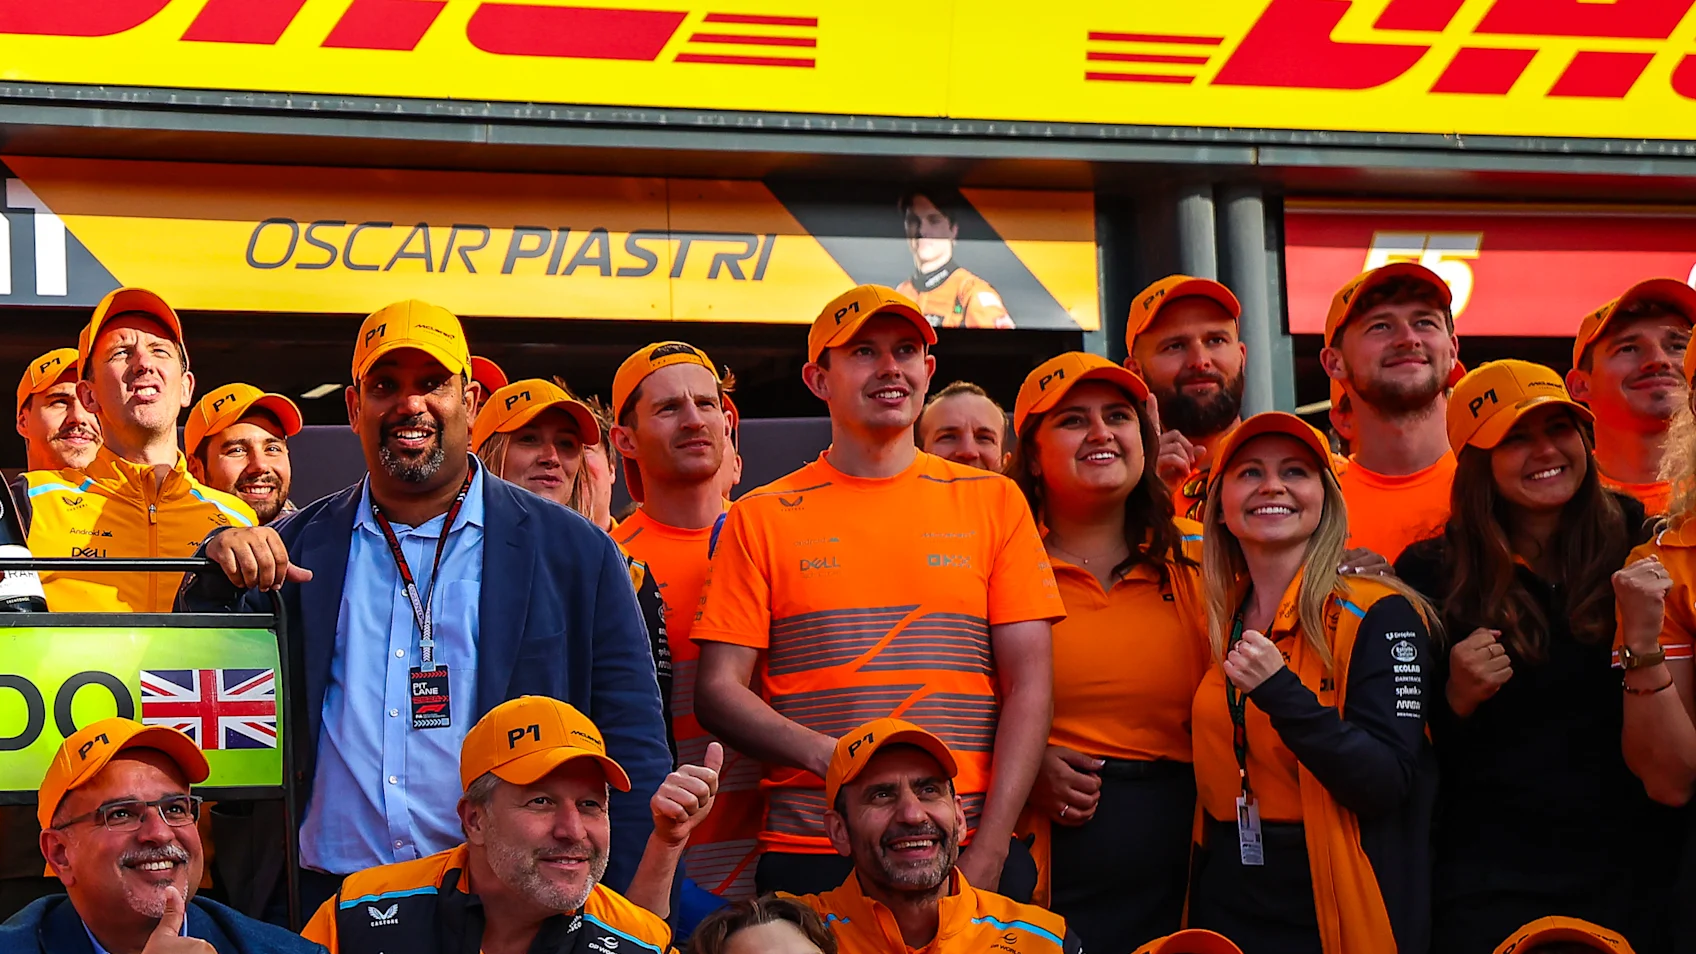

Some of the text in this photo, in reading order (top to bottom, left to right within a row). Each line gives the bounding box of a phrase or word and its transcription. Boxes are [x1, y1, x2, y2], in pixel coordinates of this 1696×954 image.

[246, 217, 777, 283] OSCAR PIASTRI
[1141, 288, 1166, 311] P1
[834, 301, 860, 326] P1
[364, 323, 387, 348] P1
[40, 357, 61, 374] P1
[1038, 367, 1066, 391] P1
[212, 393, 237, 412] P1
[504, 389, 532, 411] P1
[1468, 387, 1499, 418] P1
[70, 526, 100, 537] Android
[800, 556, 841, 571] DELL
[927, 554, 972, 568] OKX
[1393, 665, 1421, 673] ECOLAB
[413, 682, 427, 690] PIT
[413, 688, 439, 696] LANE
[507, 724, 542, 749] P1
[847, 732, 875, 759] P1
[77, 733, 110, 761] P1
[371, 918, 399, 927] CASTORE
[588, 942, 600, 951] DP
